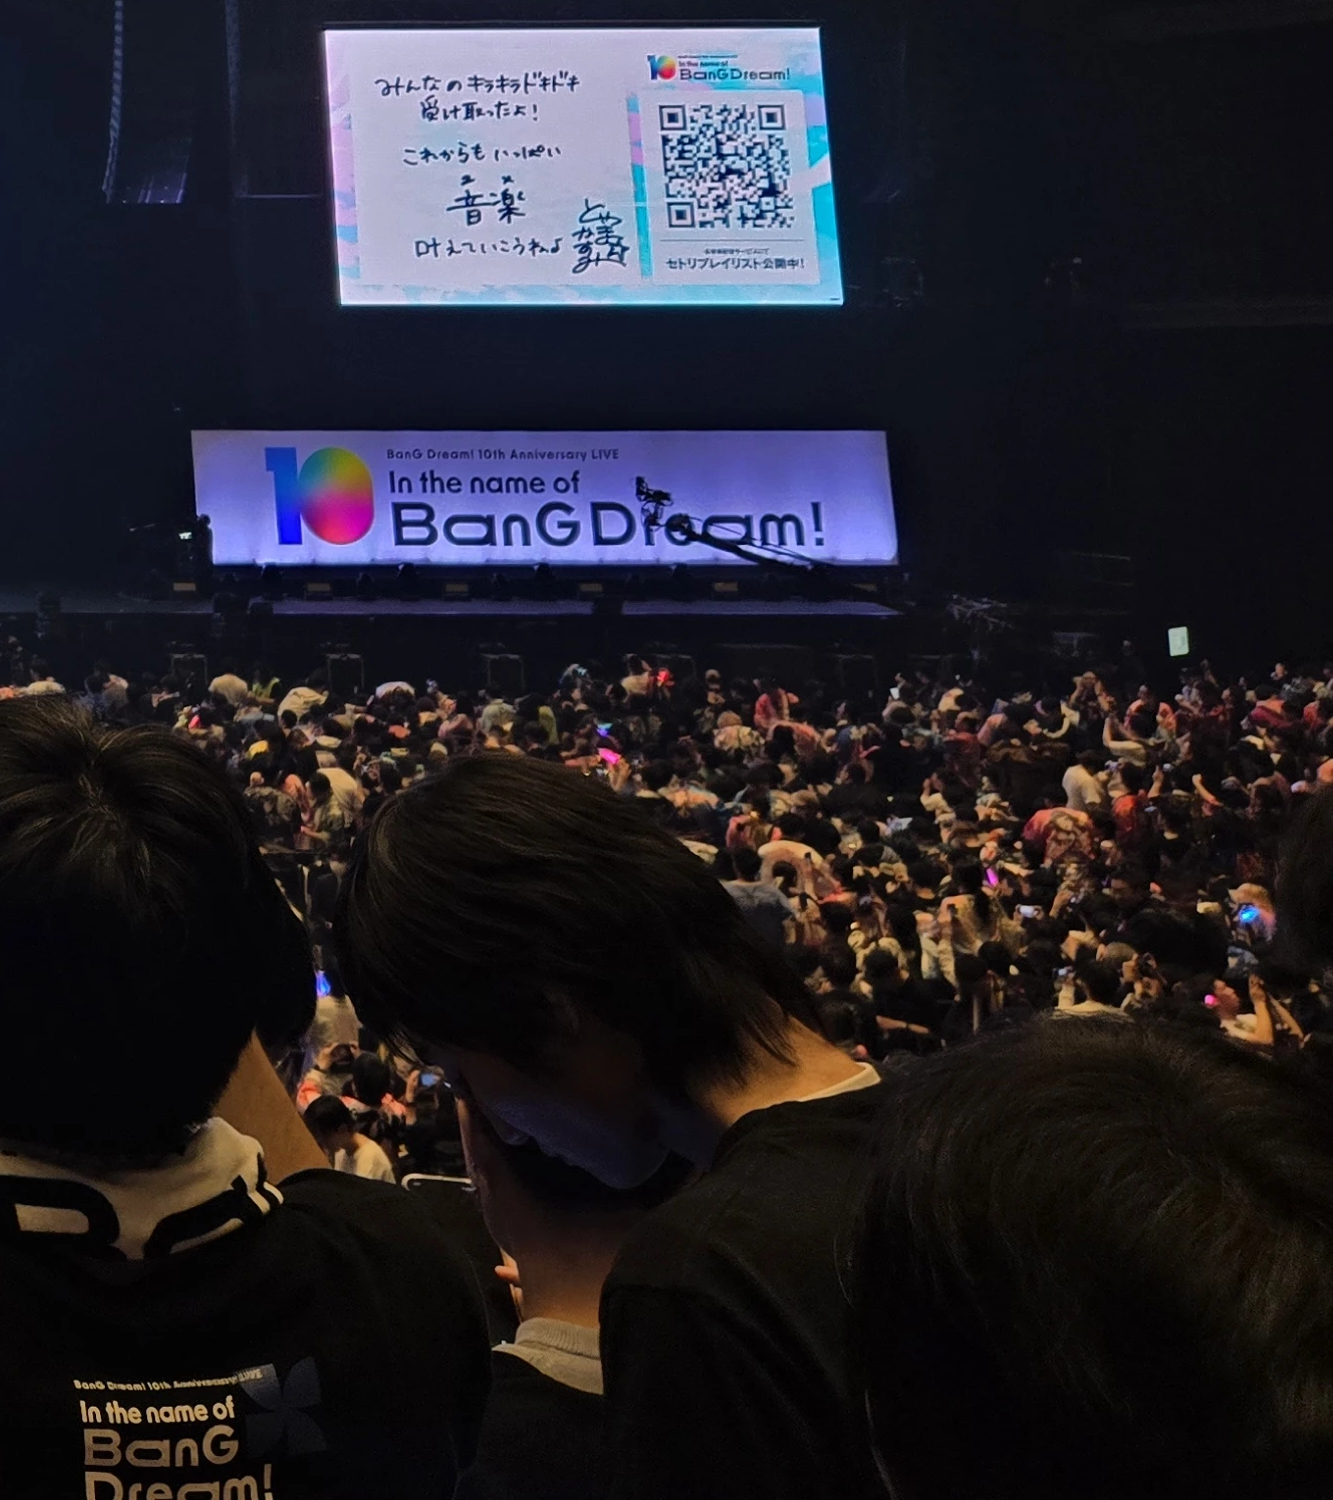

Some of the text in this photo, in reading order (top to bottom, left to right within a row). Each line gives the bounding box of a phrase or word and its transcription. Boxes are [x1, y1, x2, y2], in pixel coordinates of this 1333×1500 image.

[386, 448, 619, 462] BanG Dream! 10th Anniversary LIVE
[388, 469, 580, 494] In the name of
[73, 1379, 106, 1390] BanG
[79, 1394, 235, 1424] In the name of
[83, 1424, 239, 1468] BanG
